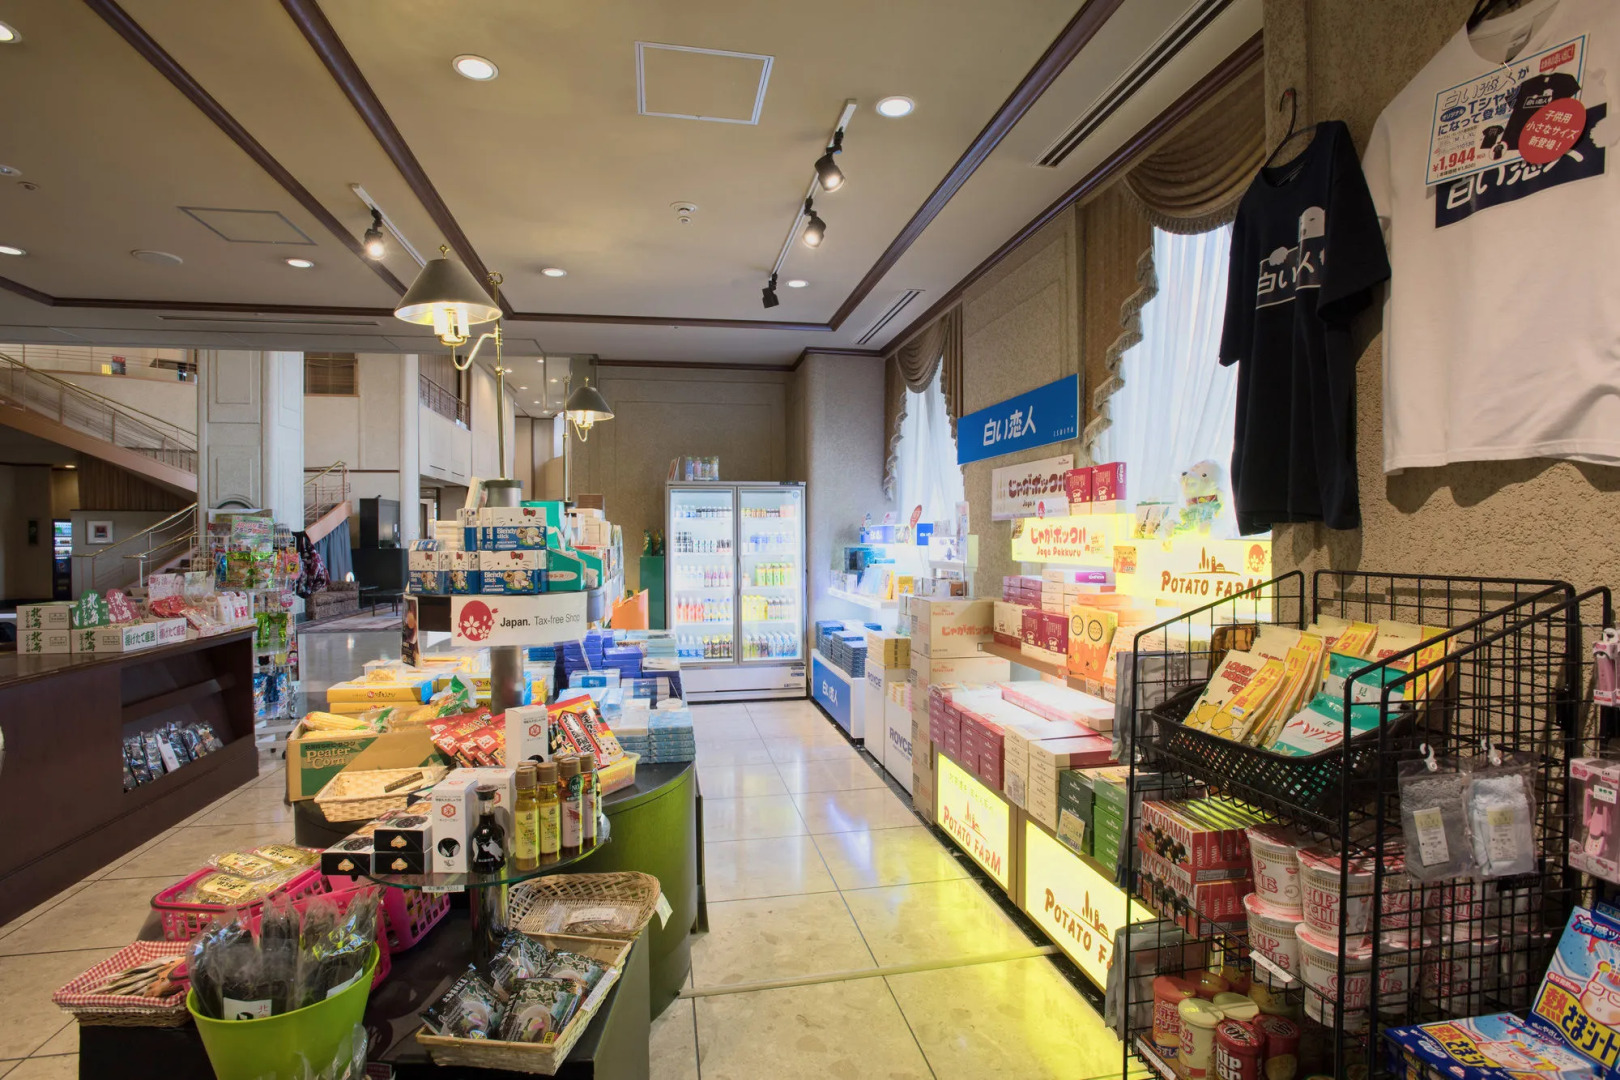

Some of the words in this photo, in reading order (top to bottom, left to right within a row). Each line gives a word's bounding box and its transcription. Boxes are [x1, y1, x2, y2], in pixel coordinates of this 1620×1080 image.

[1545, 110, 1573, 124] 子供用
[1526, 121, 1580, 140] 小さなサイズ
[1528, 136, 1562, 151] 新登場!
[1432, 147, 1476, 172] ¥1,944
[982, 405, 1037, 447] 白い恋人
[1030, 524, 1087, 545] じゃがポックル
[1161, 570, 1209, 596] POTATO
[1215, 578, 1263, 602] FARM
[500, 617, 531, 629] Japan.
[534, 615, 564, 627] Tax-free
[565, 613, 581, 623] Shop
[1228, 683, 1243, 696] FO
[1287, 720, 1344, 743] ハッカ
[312, 757, 347, 769] Corn
[1142, 801, 1191, 848] MACADAMIA
[943, 805, 972, 849] POTATO
[974, 840, 1001, 876] FARM
[1142, 851, 1195, 901] MACADAMIA
[1045, 888, 1092, 952] POTATO
[1538, 987, 1620, 1060] 熱さまシート
[1217, 1046, 1243, 1070] hip
[1217, 1063, 1242, 1080] tar
